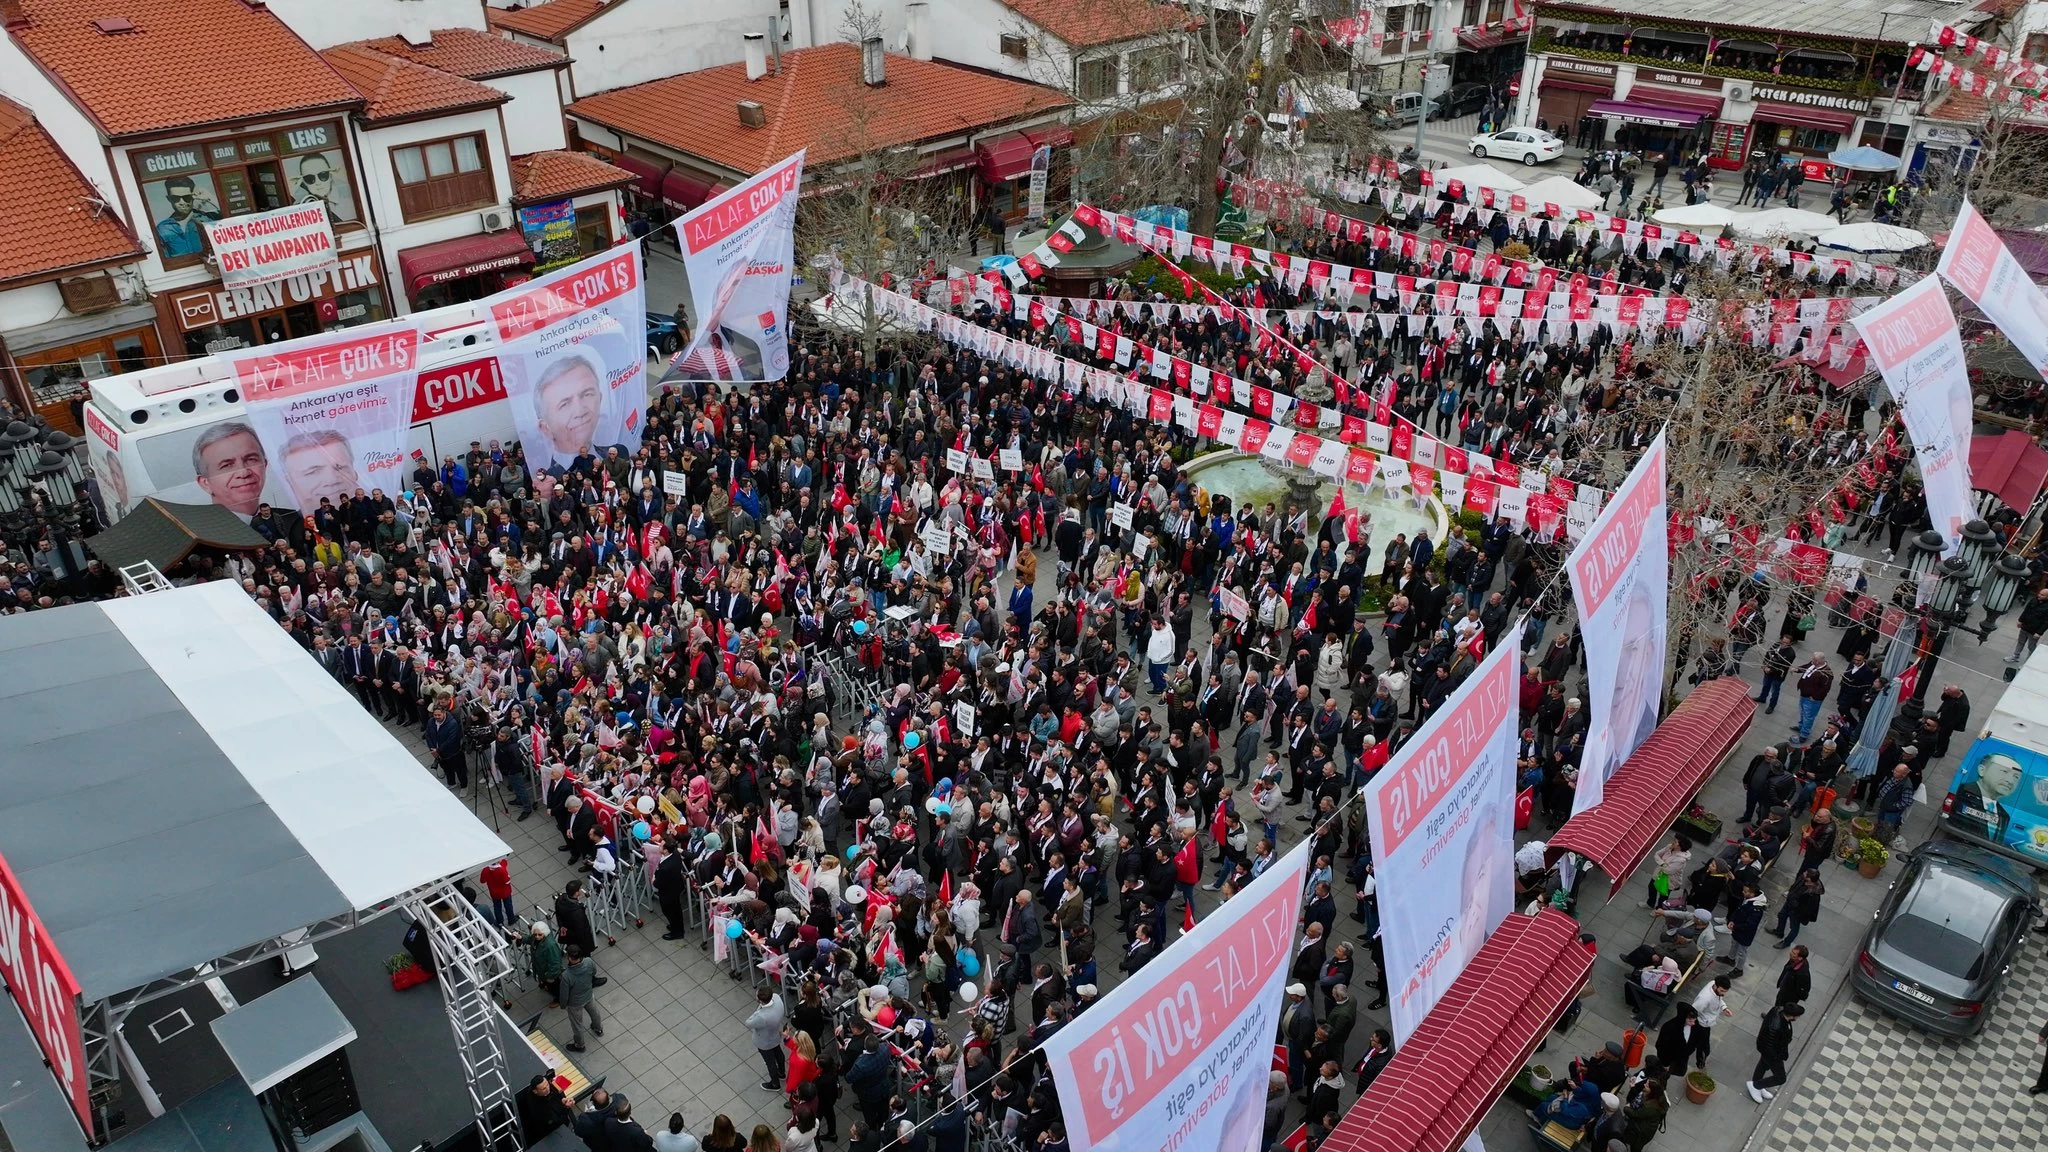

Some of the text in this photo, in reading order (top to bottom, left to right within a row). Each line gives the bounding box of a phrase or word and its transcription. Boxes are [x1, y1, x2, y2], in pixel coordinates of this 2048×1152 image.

[1681, 76, 1703, 86] MANAV
[1752, 87, 1869, 112] PETEK PASTANELERİ
[288, 127, 327, 150] LENS
[245, 140, 271, 154] OPTİK
[214, 146, 235, 159] ERAY
[146, 151, 197, 172] GÖZLÜK
[692, 220, 717, 246] AZ
[748, 185, 780, 216] ÇOK
[781, 169, 794, 194] İŞ
[212, 208, 323, 244] GÜNEŞ GÖZLÜKLERİNDE
[720, 222, 760, 253] Ankara'ya
[221, 231, 331, 272] DEV KAMPANYA
[432, 269, 461, 282] FIRAT
[465, 256, 521, 275] KURUYEMİŞ
[215, 279, 284, 320] ERAY
[505, 300, 527, 333] AZ
[571, 269, 611, 310] ÇOK
[612, 260, 630, 291] İŞ
[1460, 293, 1474, 302] CHP
[1482, 298, 1495, 307] CHP
[1504, 299, 1519, 307] CHP
[1550, 303, 1565, 311] CHP
[1573, 307, 1587, 315] CHP
[1622, 311, 1636, 319] CHP
[1804, 310, 1820, 319] CHP
[539, 307, 610, 344] Ankara'ya eşit
[535, 336, 570, 359] hizmet
[253, 361, 284, 393] AZ
[340, 342, 384, 380] ÇOK
[389, 336, 409, 369] İŞ
[1193, 377, 1205, 387] CHP
[424, 367, 486, 413] ÇOK
[1237, 389, 1248, 399] CHP
[290, 383, 379, 412] Ankara'ya eşit
[1153, 403, 1167, 412] CHP
[1258, 399, 1269, 407] CHP
[284, 395, 388, 426] hizmet görevimiz
[1202, 420, 1216, 430] CHP
[1299, 416, 1311, 424] CHP
[1320, 420, 1336, 429] CHP
[1221, 426, 1236, 436] CHP
[1246, 435, 1262, 445] CHP
[1370, 434, 1385, 444] CHP
[1266, 440, 1282, 450] CHP
[1395, 442, 1408, 451] CHP
[1295, 447, 1310, 457] CHP
[1417, 450, 1432, 460] CHP
[1318, 455, 1335, 466] CHP
[1351, 465, 1367, 475] CHP
[1386, 469, 1403, 478] CHP
[1524, 483, 1541, 492] CHP
[1470, 496, 1487, 505] CHP
[1502, 503, 1520, 511] CHP
[1568, 517, 1586, 527] CHP
[28, 915, 74, 1101] İŞ
